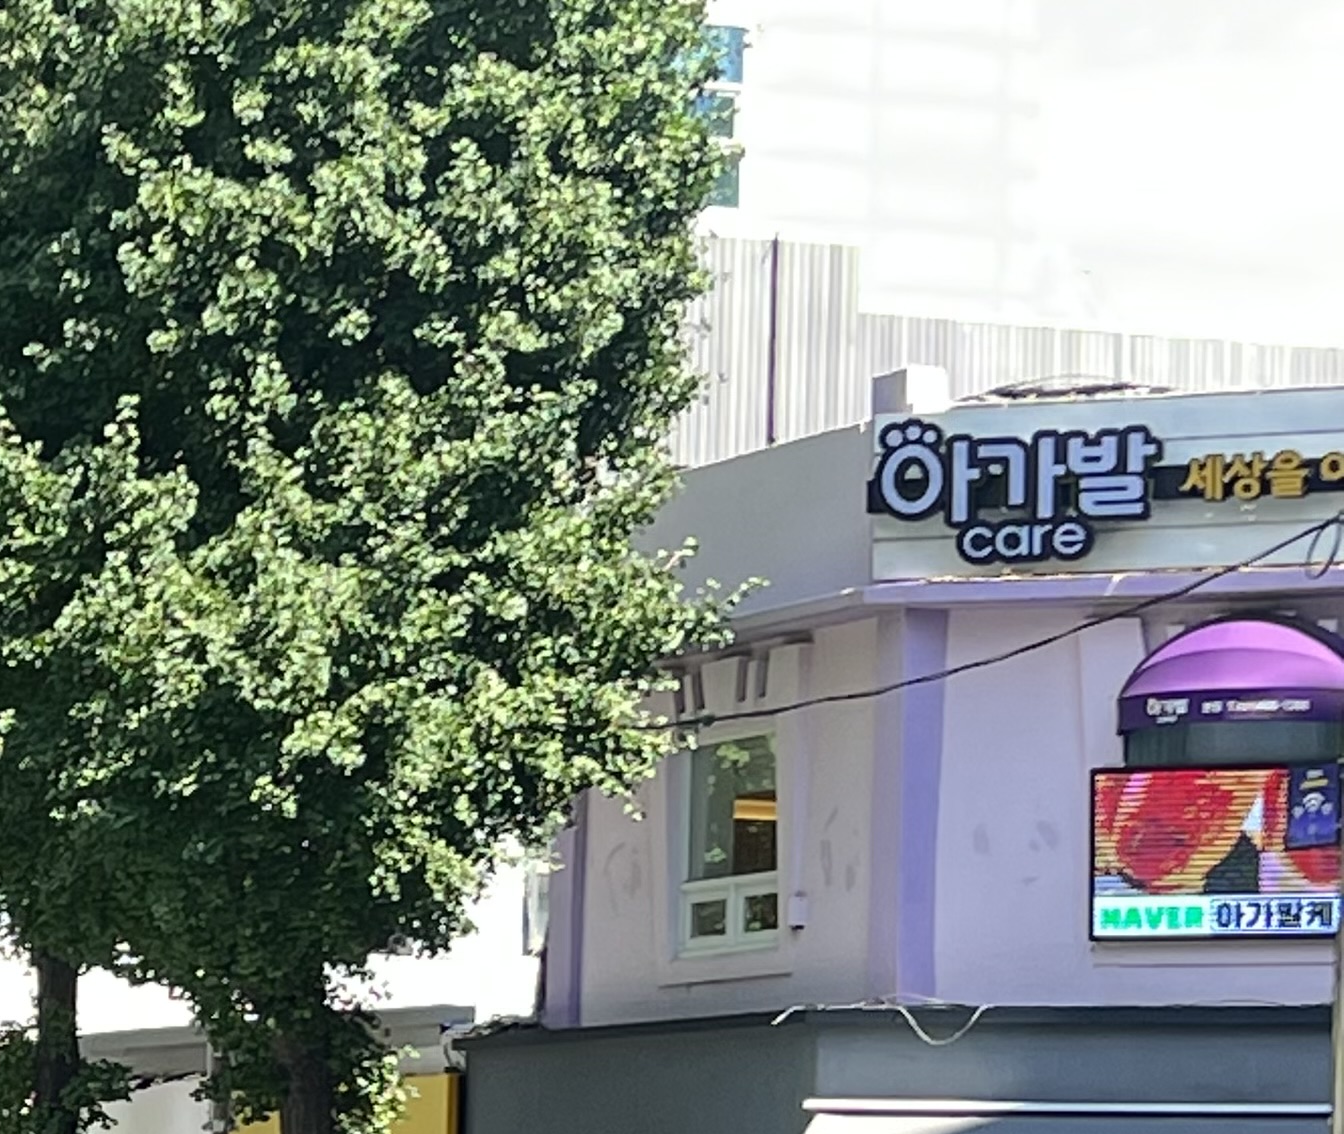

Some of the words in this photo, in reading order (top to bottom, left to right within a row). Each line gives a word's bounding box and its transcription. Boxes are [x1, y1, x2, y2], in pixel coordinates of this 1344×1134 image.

[879, 421, 1160, 523] 아가발
[1179, 450, 1310, 500] 세상을
[962, 523, 1088, 559] care
[1100, 906, 1204, 930] NAVER
